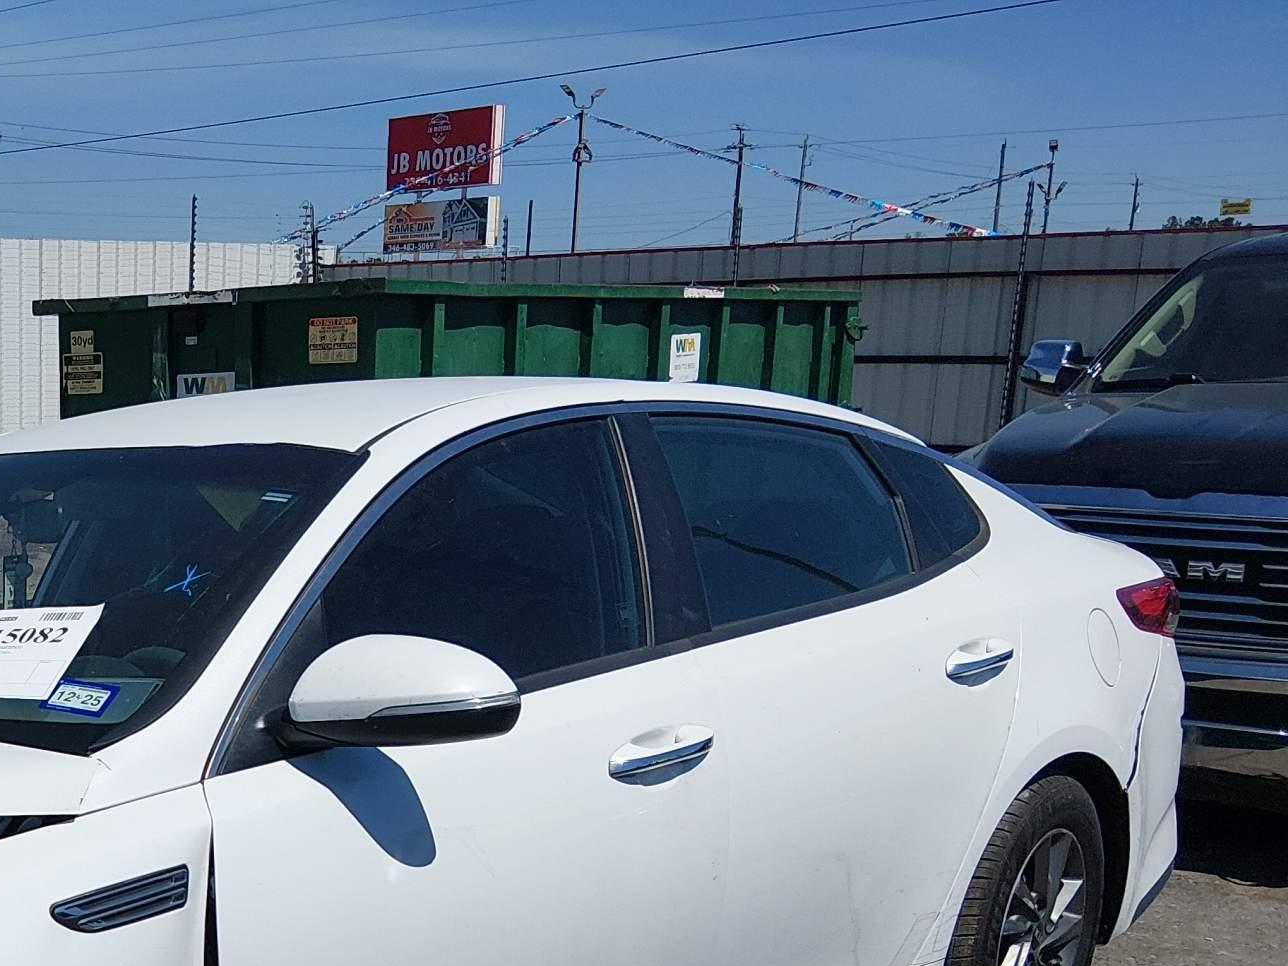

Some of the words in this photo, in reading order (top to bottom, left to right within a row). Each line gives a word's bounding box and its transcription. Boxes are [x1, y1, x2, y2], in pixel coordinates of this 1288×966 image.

[391, 152, 410, 174] JB
[416, 143, 488, 171] MOTORS
[388, 223, 415, 233] SAME
[417, 222, 435, 231] DAY
[72, 336, 93, 348] 30yd
[183, 376, 227, 395] WM
[57, 690, 76, 702] 12
[81, 694, 104, 707] 25
